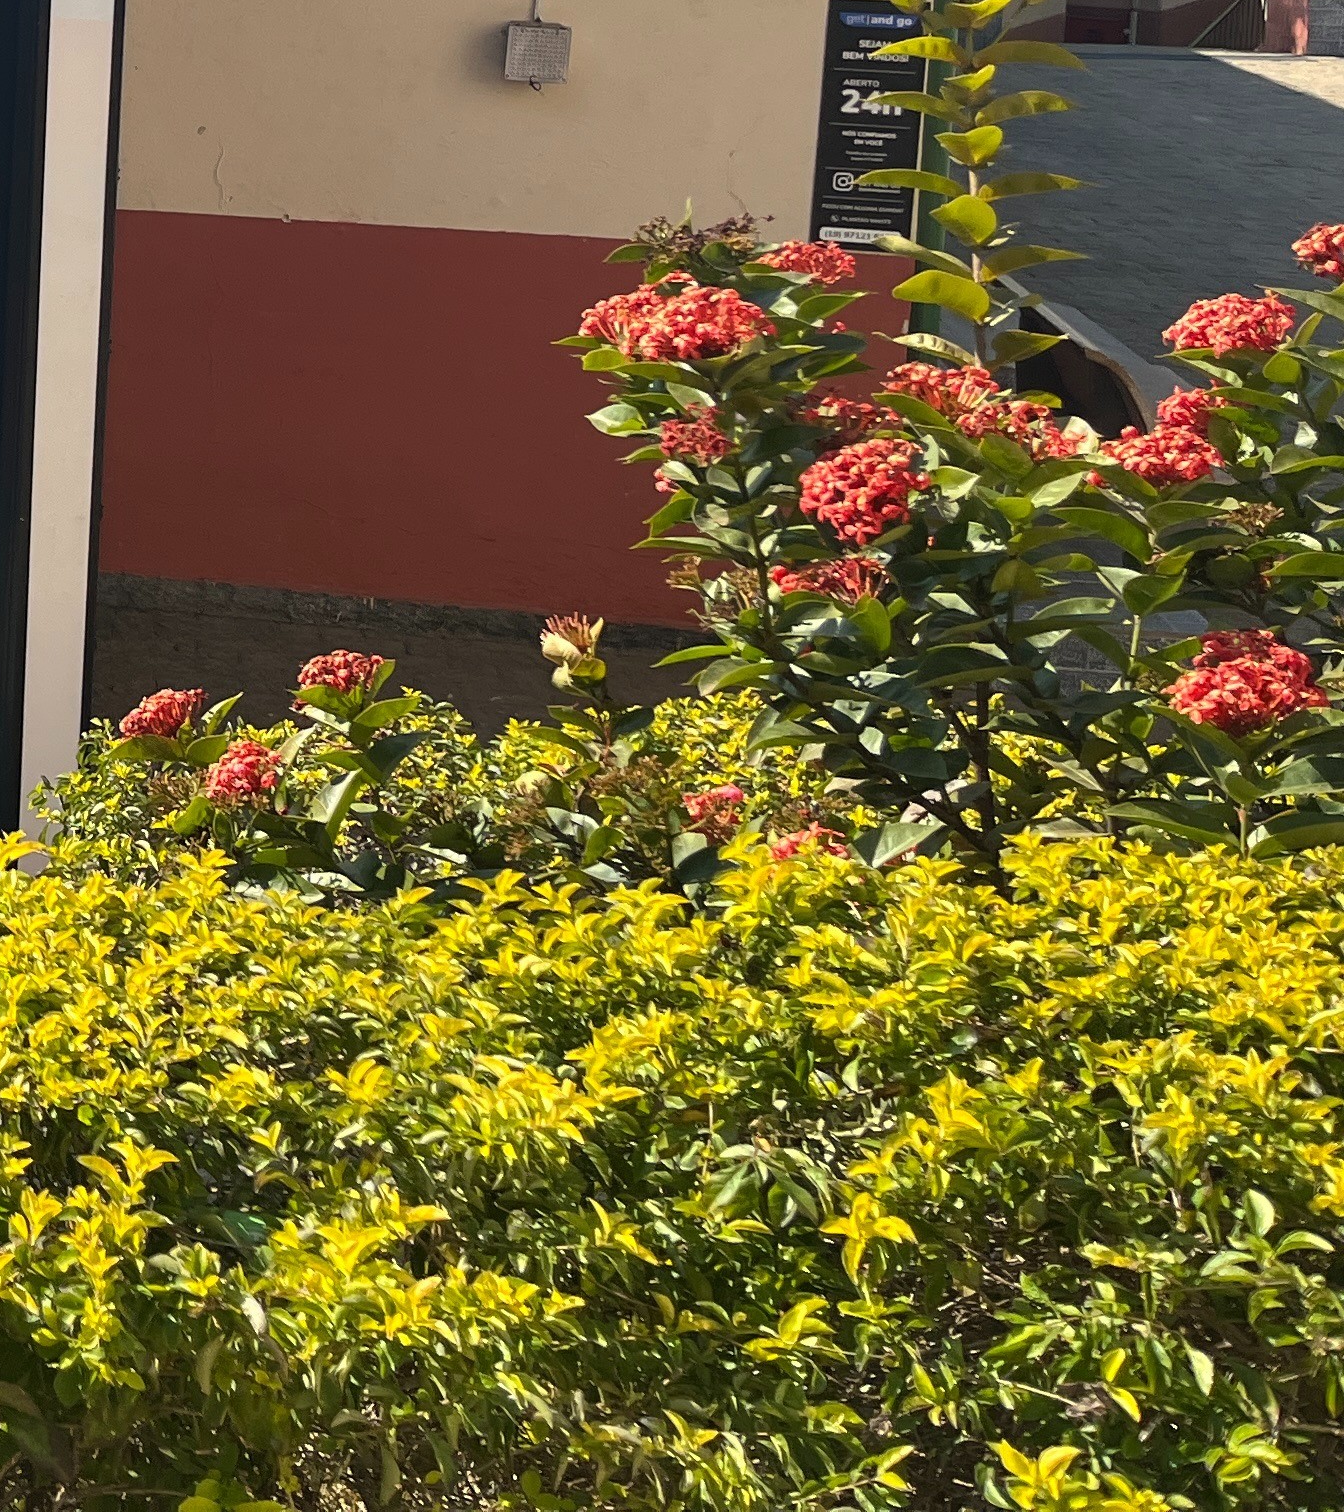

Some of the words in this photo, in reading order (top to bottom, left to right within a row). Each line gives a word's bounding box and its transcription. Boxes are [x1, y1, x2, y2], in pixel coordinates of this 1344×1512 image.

[870, 15, 894, 25] and
[896, 18, 913, 27] go
[842, 51, 864, 60] BEM
[843, 78, 880, 88] ABERTO
